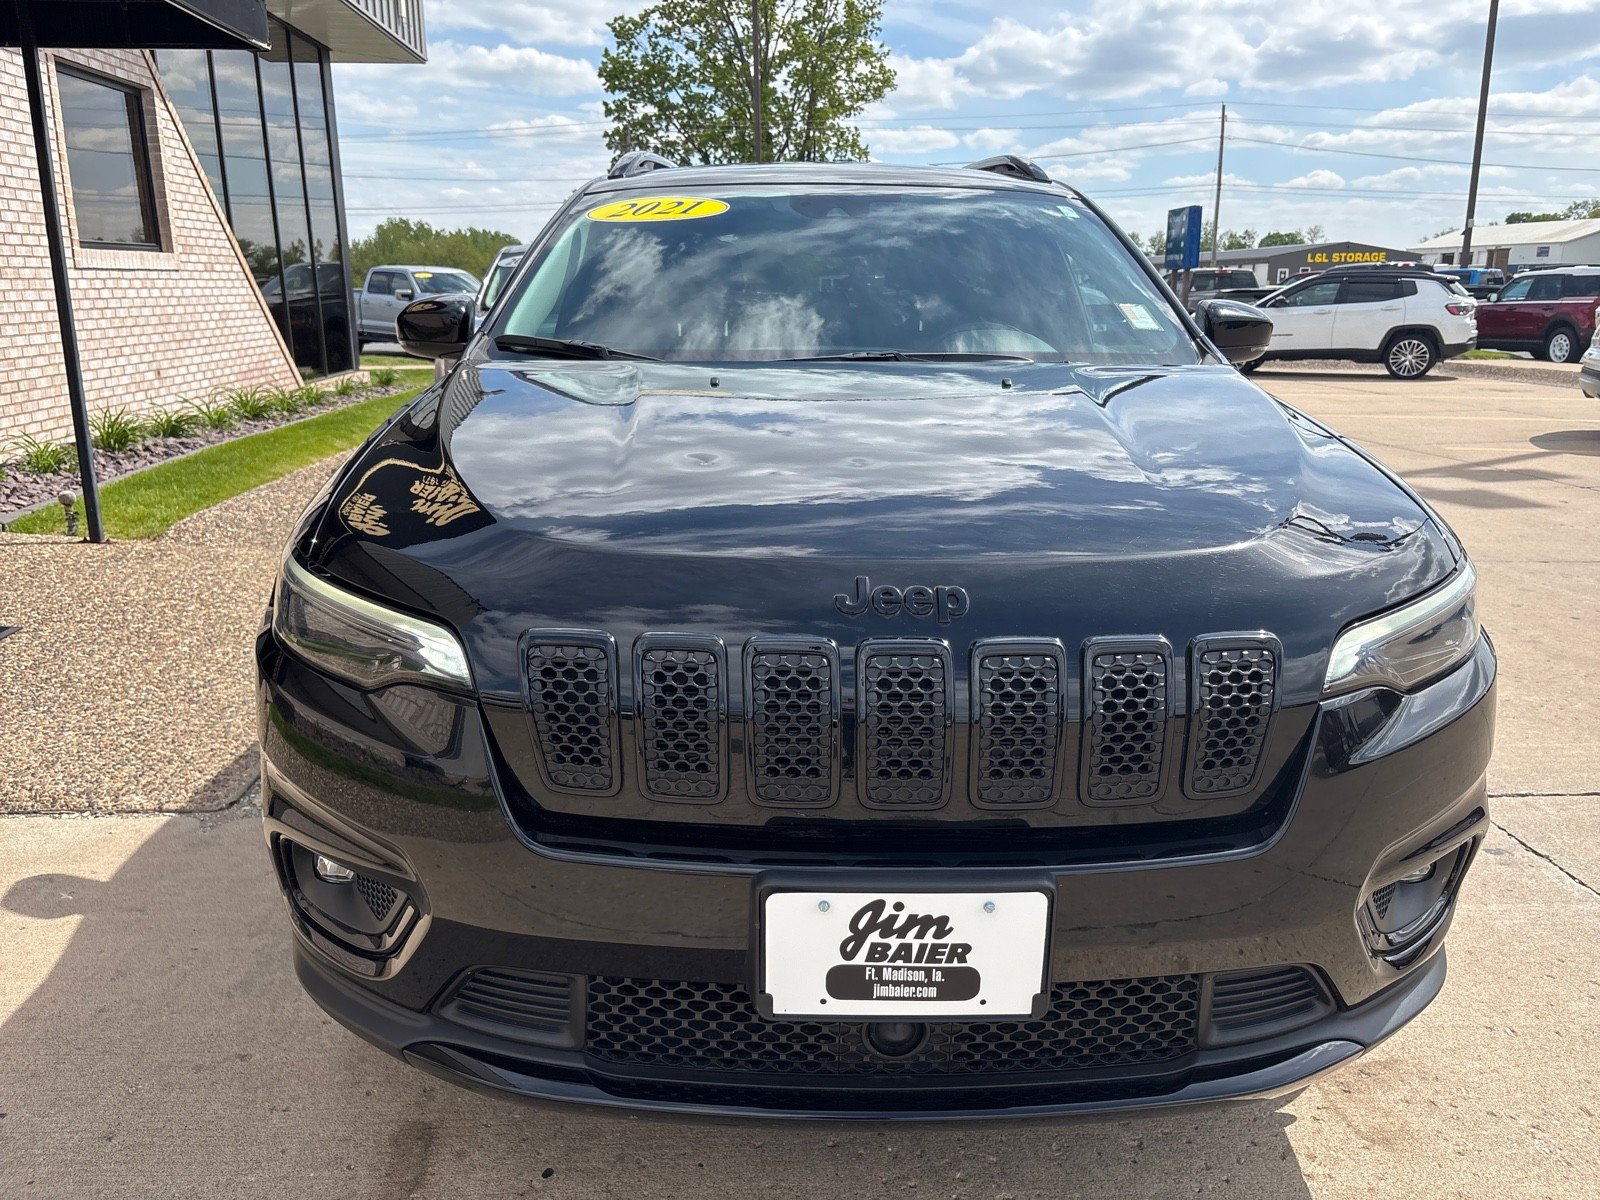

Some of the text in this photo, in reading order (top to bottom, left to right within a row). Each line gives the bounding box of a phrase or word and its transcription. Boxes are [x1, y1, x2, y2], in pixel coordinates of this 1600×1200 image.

[606, 201, 706, 218] 2021
[1306, 252, 1387, 263] L&L STORAGE
[833, 575, 970, 625] Jeep
[839, 898, 954, 962] Jim
[864, 941, 972, 964] BAIER
[865, 966, 945, 984] Ft. Madison, Ia.
[873, 983, 937, 999] jimbaier.com
